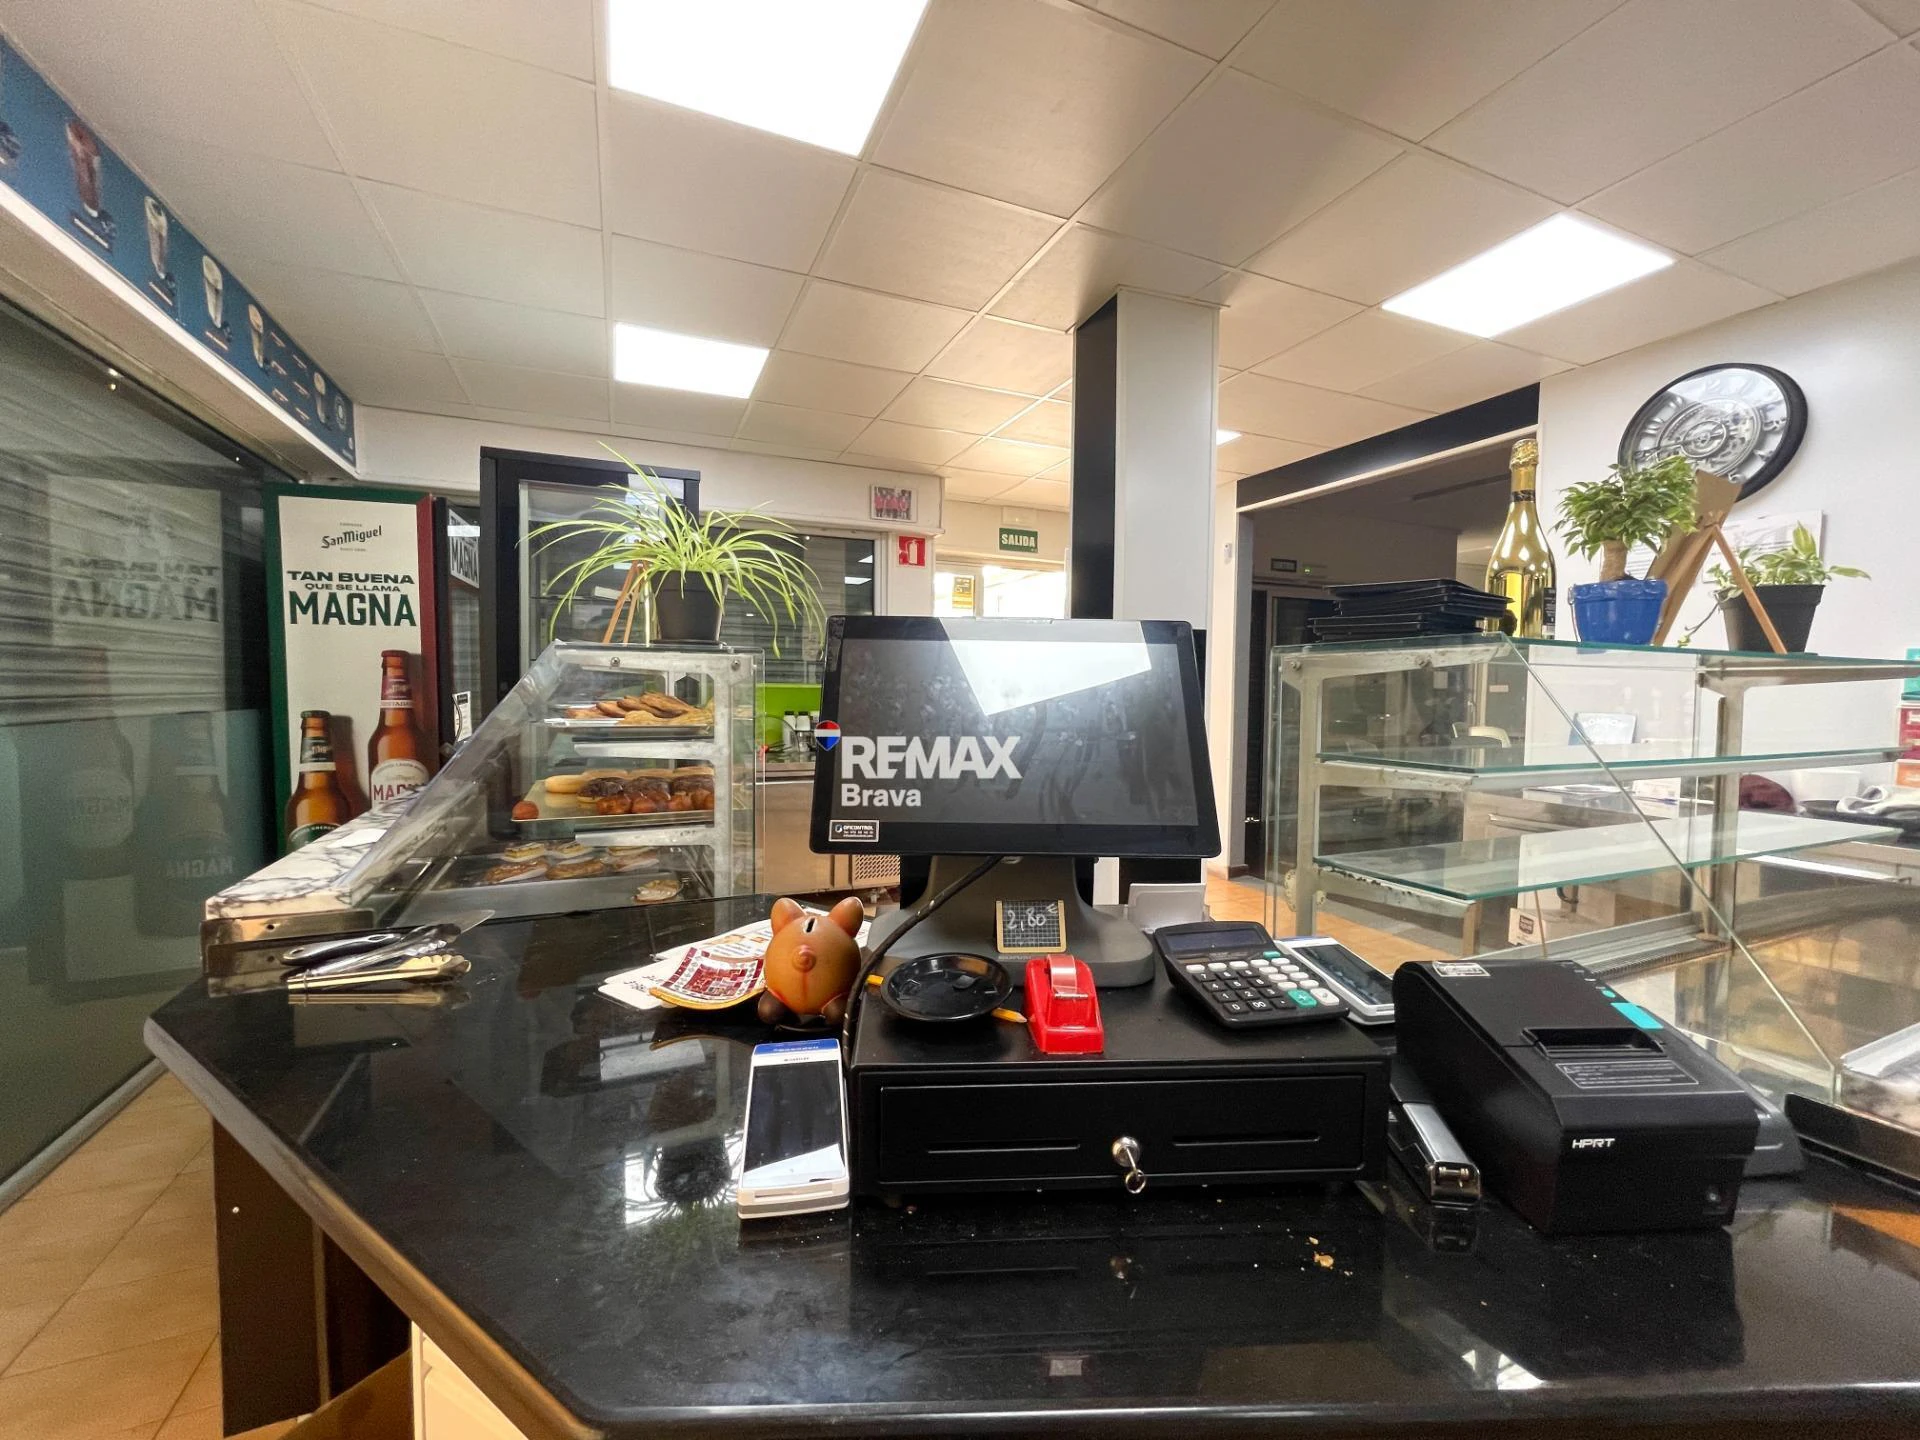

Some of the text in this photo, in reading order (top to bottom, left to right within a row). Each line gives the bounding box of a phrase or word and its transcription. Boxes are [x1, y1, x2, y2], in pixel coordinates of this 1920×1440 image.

[1001, 533, 1036, 548] SALIDA
[286, 570, 415, 585] TAN BUENA
[304, 582, 401, 592] QUE SE LLAMA
[288, 591, 417, 626] MAGNA
[1572, 1138, 1616, 1149] HPRT
